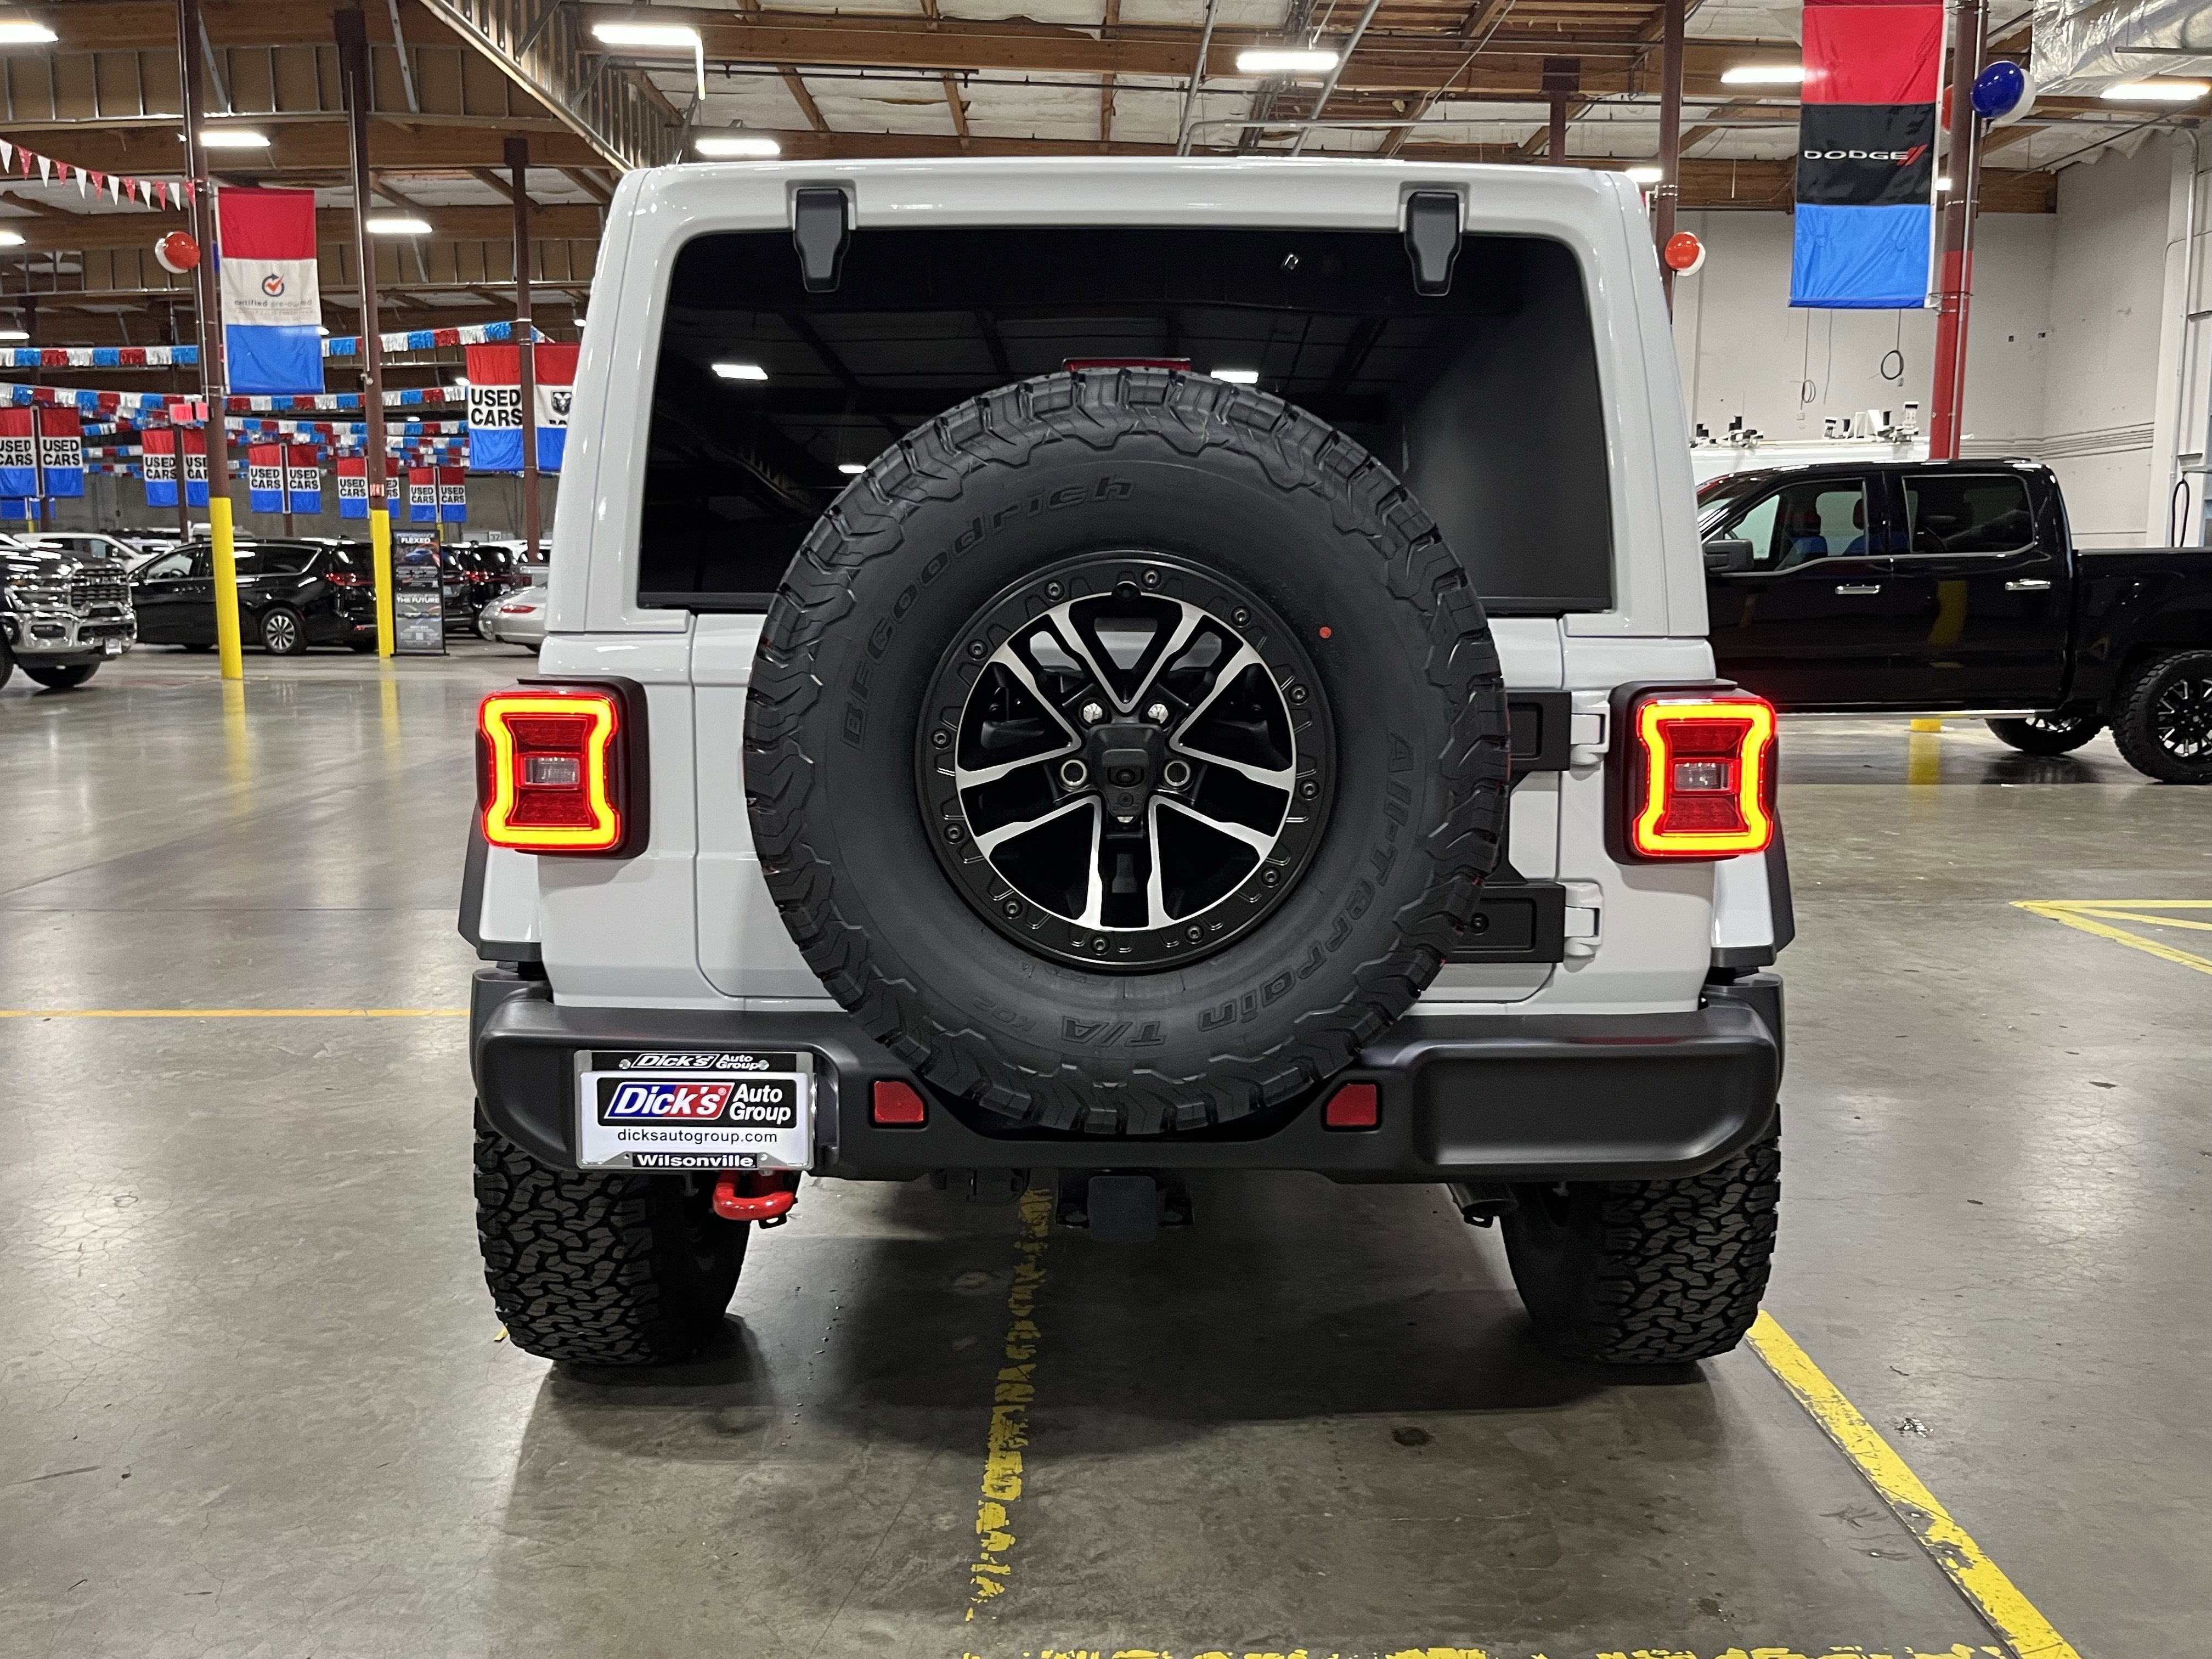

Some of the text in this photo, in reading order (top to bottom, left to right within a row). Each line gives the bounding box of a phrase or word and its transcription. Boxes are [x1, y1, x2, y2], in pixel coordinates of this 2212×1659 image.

[1804, 150, 1909, 160] DODGE
[471, 388, 521, 407] USED
[471, 408, 523, 427] CARS
[43, 439, 80, 452] USED
[43, 454, 80, 466] CARS
[145, 456, 176, 467] USED
[186, 457, 207, 467] US
[146, 469, 177, 479] CARS
[187, 469, 208, 479] CA
[251, 469, 280, 478] USED
[289, 469, 317, 479] USED
[251, 479, 281, 489] CARS
[289, 480, 319, 489] CARS
[340, 478, 365, 488] USED
[386, 479, 397, 488] ED
[340, 488, 366, 497] CARS
[411, 487, 434, 495] USED
[441, 487, 464, 495] USED
[411, 495, 435, 504] CARS
[841, 474, 1136, 752] BFGoodrich
[1060, 1015, 1167, 1048] T/A
[636, 1054, 754, 1066] Dick's Auto
[715, 1061, 760, 1070] Group
[613, 1083, 783, 1115] Dick's Auto
[729, 1101, 792, 1125] Group
[617, 1128, 778, 1145] dicksautogroup.com
[636, 1154, 754, 1167] Wilsonville
